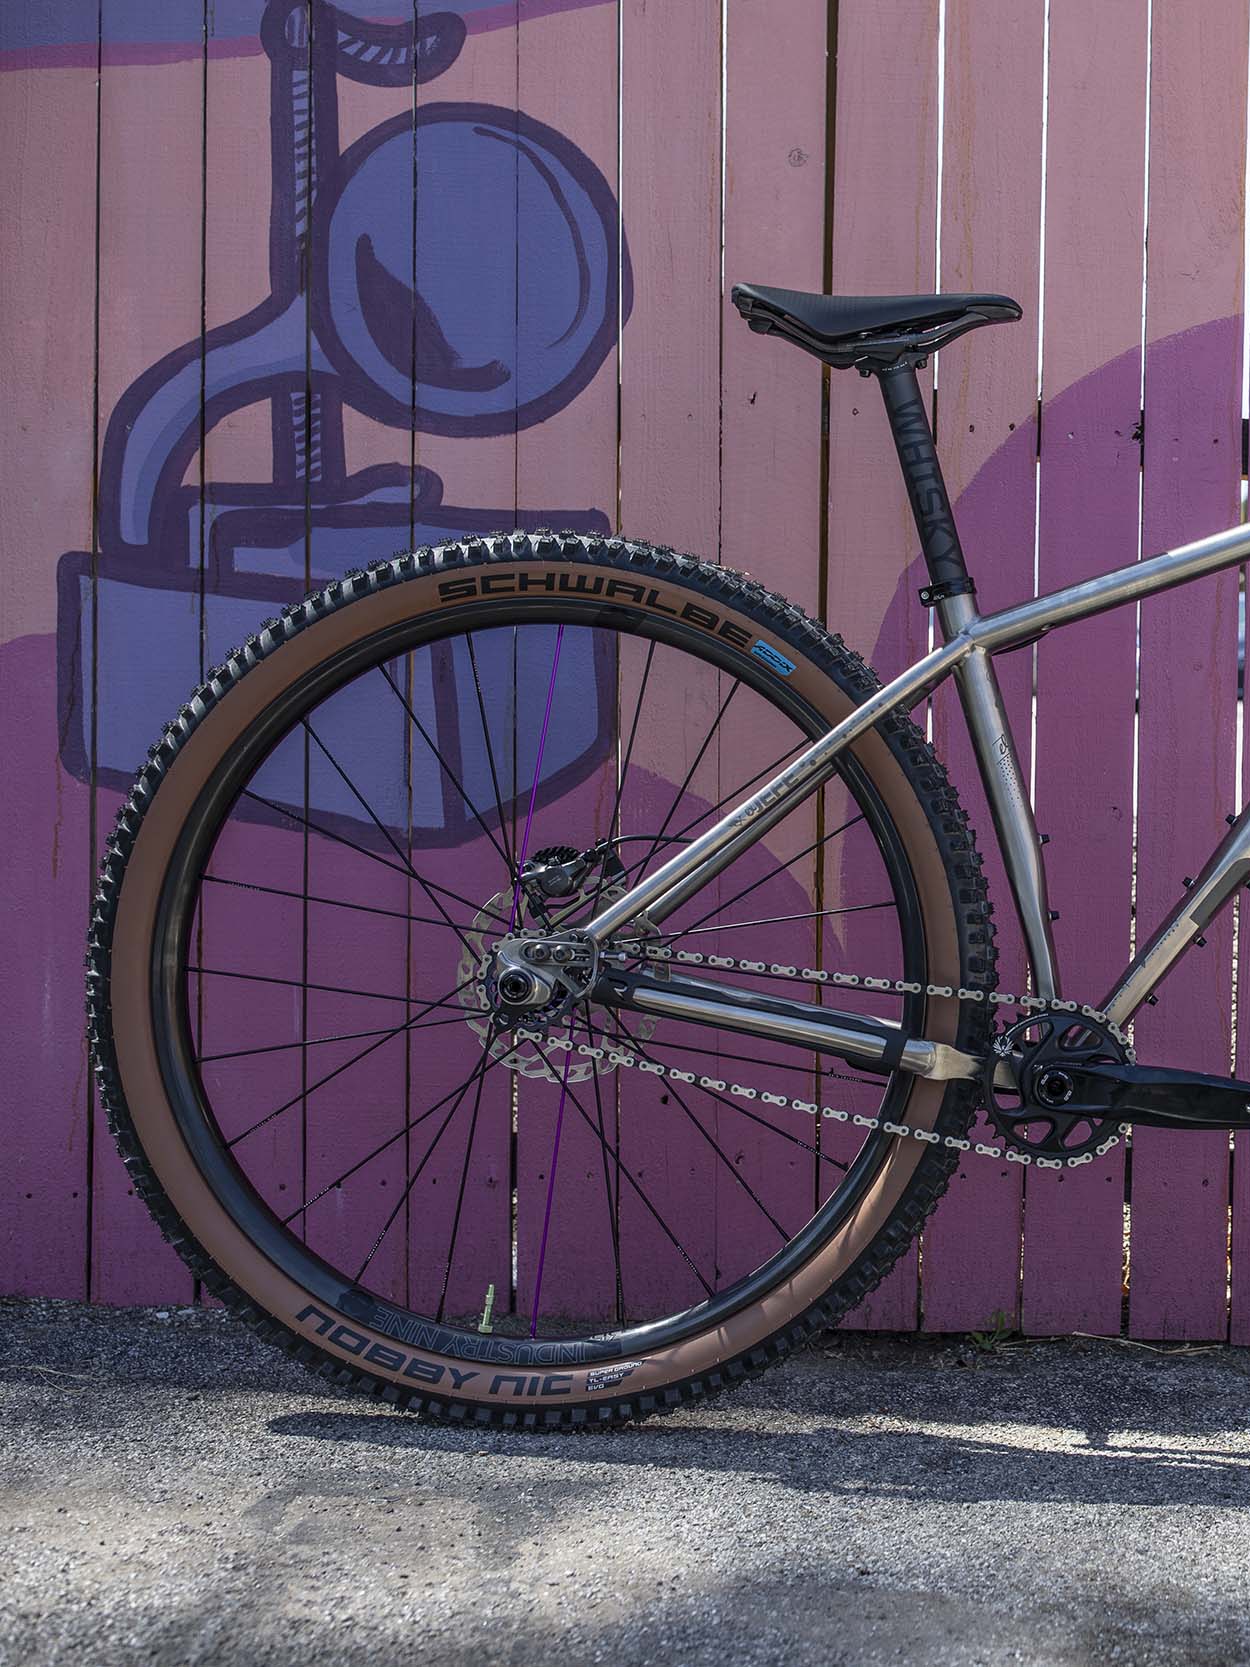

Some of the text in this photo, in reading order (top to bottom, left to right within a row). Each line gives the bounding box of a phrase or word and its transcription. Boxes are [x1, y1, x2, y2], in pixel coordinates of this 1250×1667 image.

[895, 398, 962, 567] WHISKY
[437, 572, 753, 648] SCHWALBE
[295, 1304, 574, 1397] NOBBY NIC
[369, 1305, 586, 1365] INDUSTRY NINE
[587, 1383, 605, 1391] EVO
[588, 1372, 624, 1383] TL-EASY
[589, 1360, 643, 1377] SUPER GROUND
